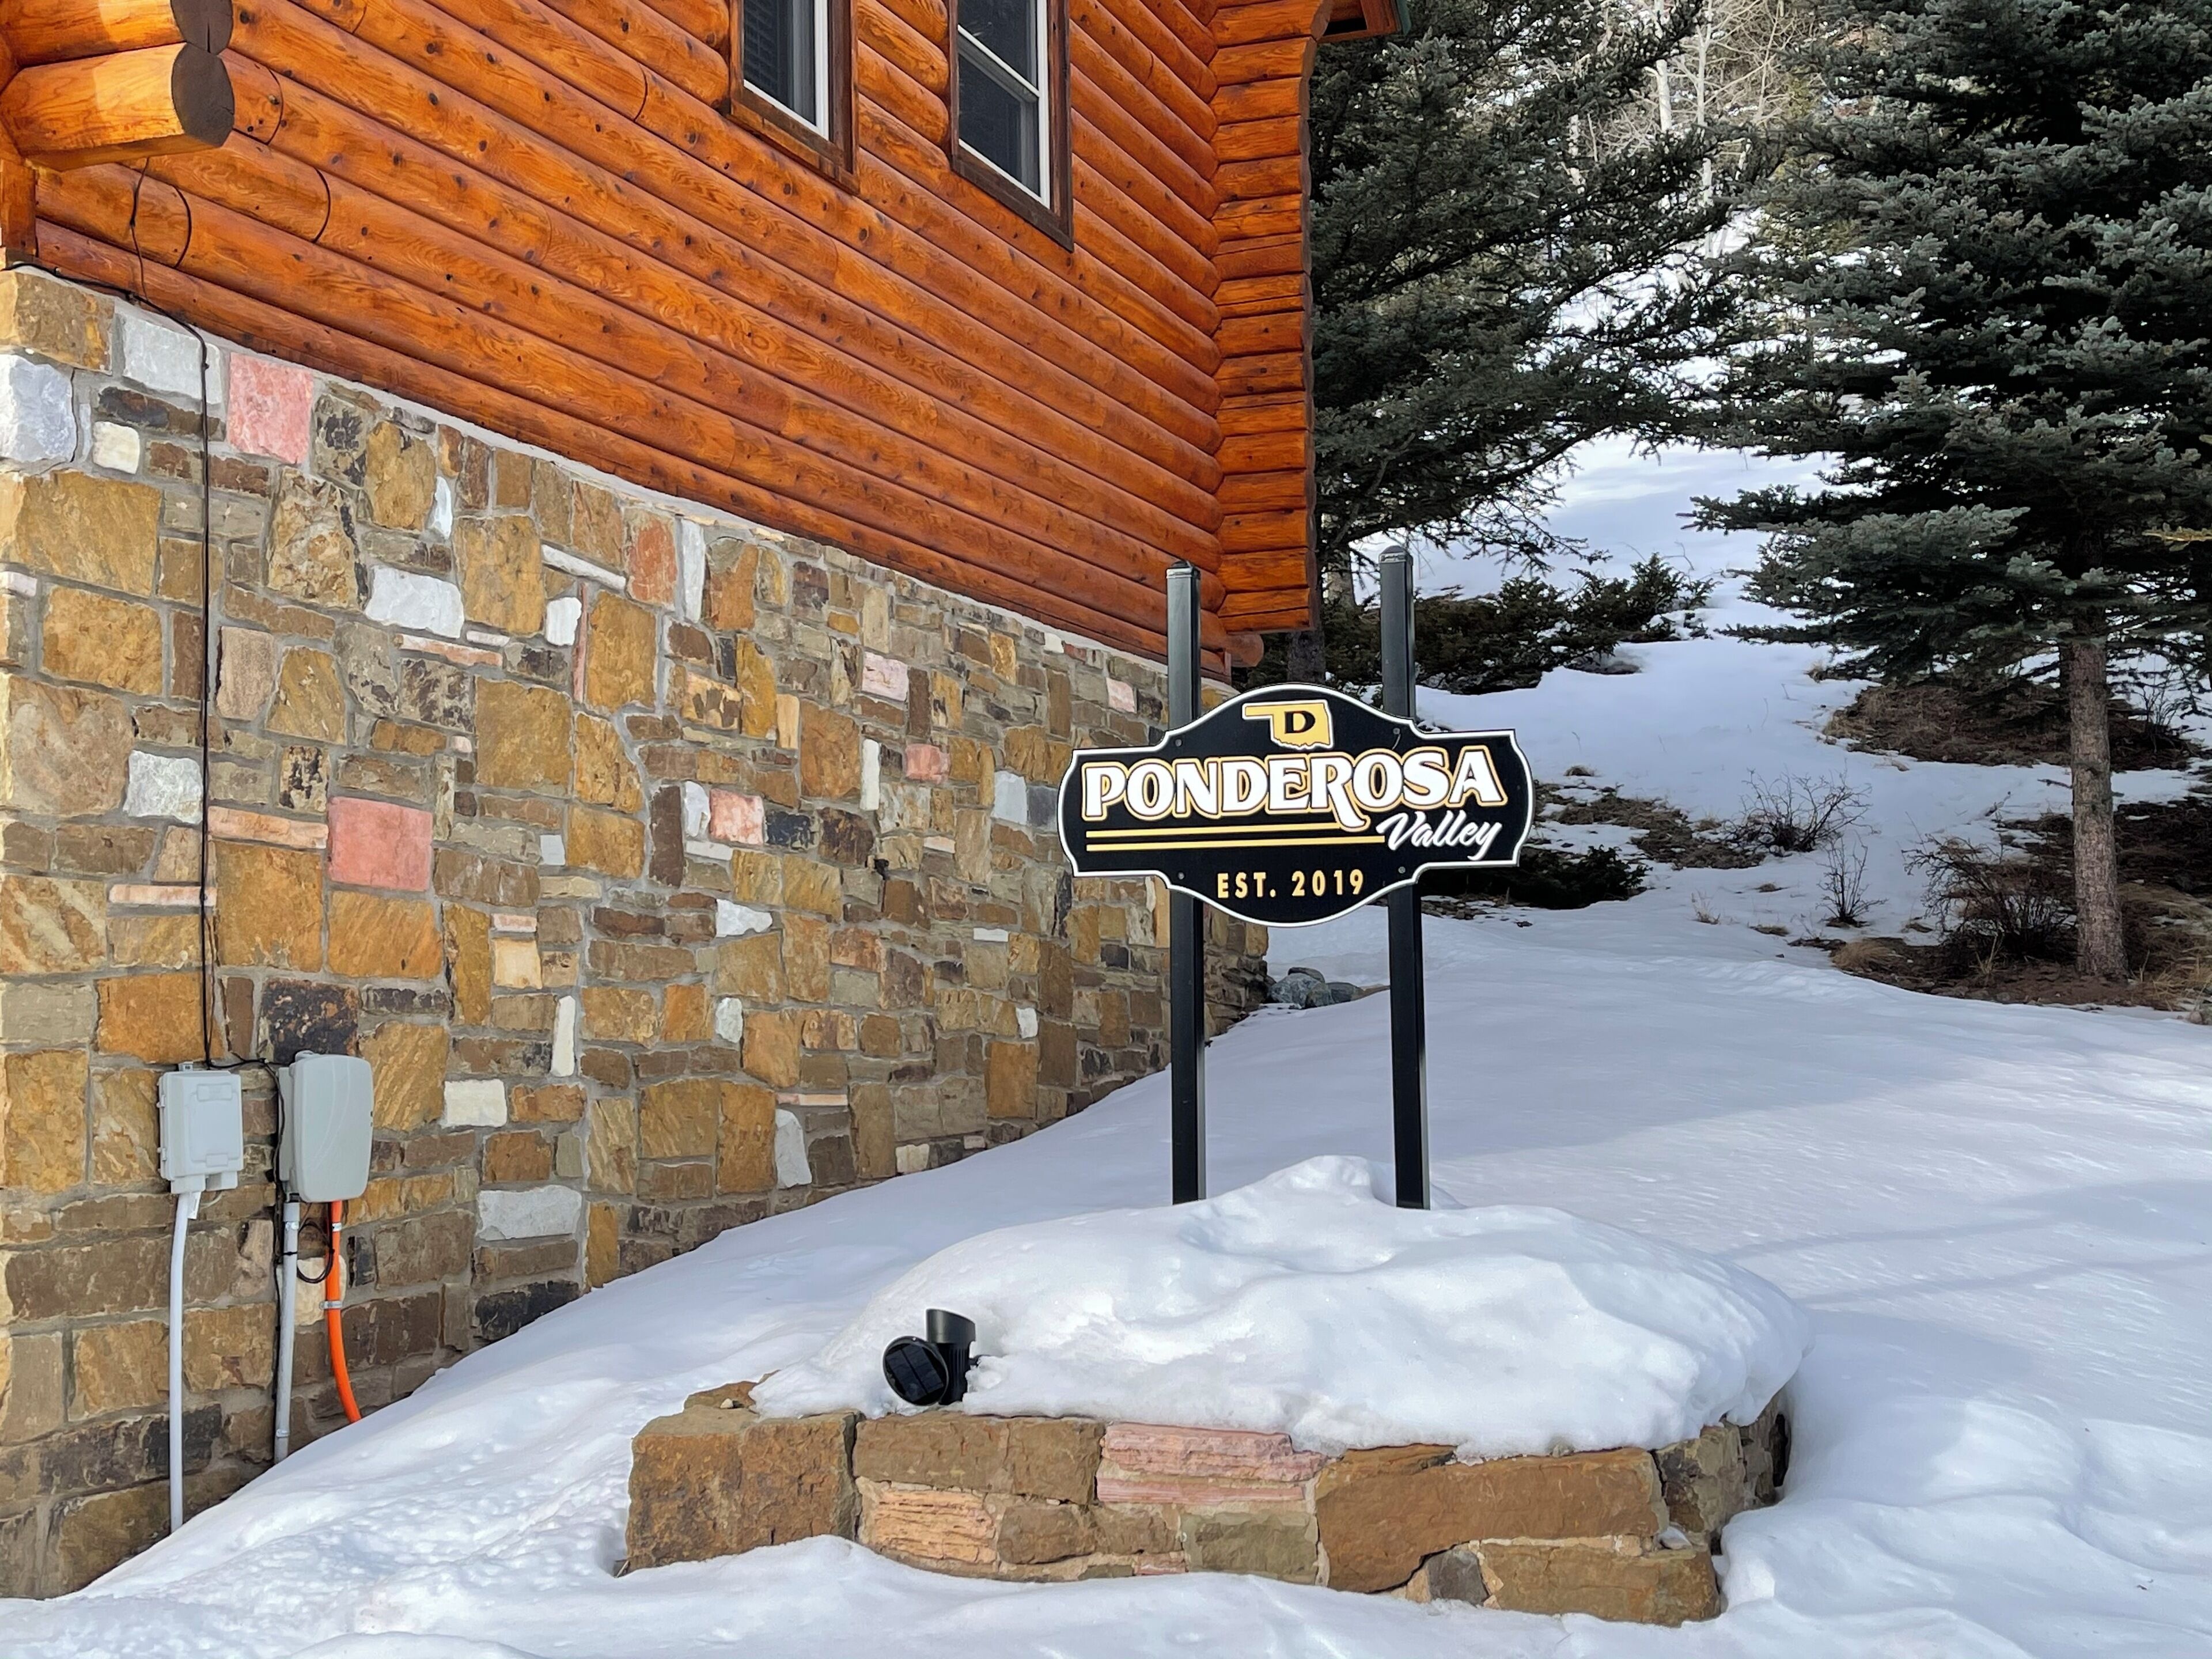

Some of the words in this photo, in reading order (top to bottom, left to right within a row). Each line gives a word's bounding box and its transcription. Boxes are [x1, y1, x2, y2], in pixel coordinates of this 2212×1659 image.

[1284, 711, 1316, 733] D
[1082, 745, 1508, 831] PONDEROSA
[1376, 810, 1502, 861] Valley
[1217, 872, 1277, 899] EST.
[1292, 869, 1364, 896] 2019
